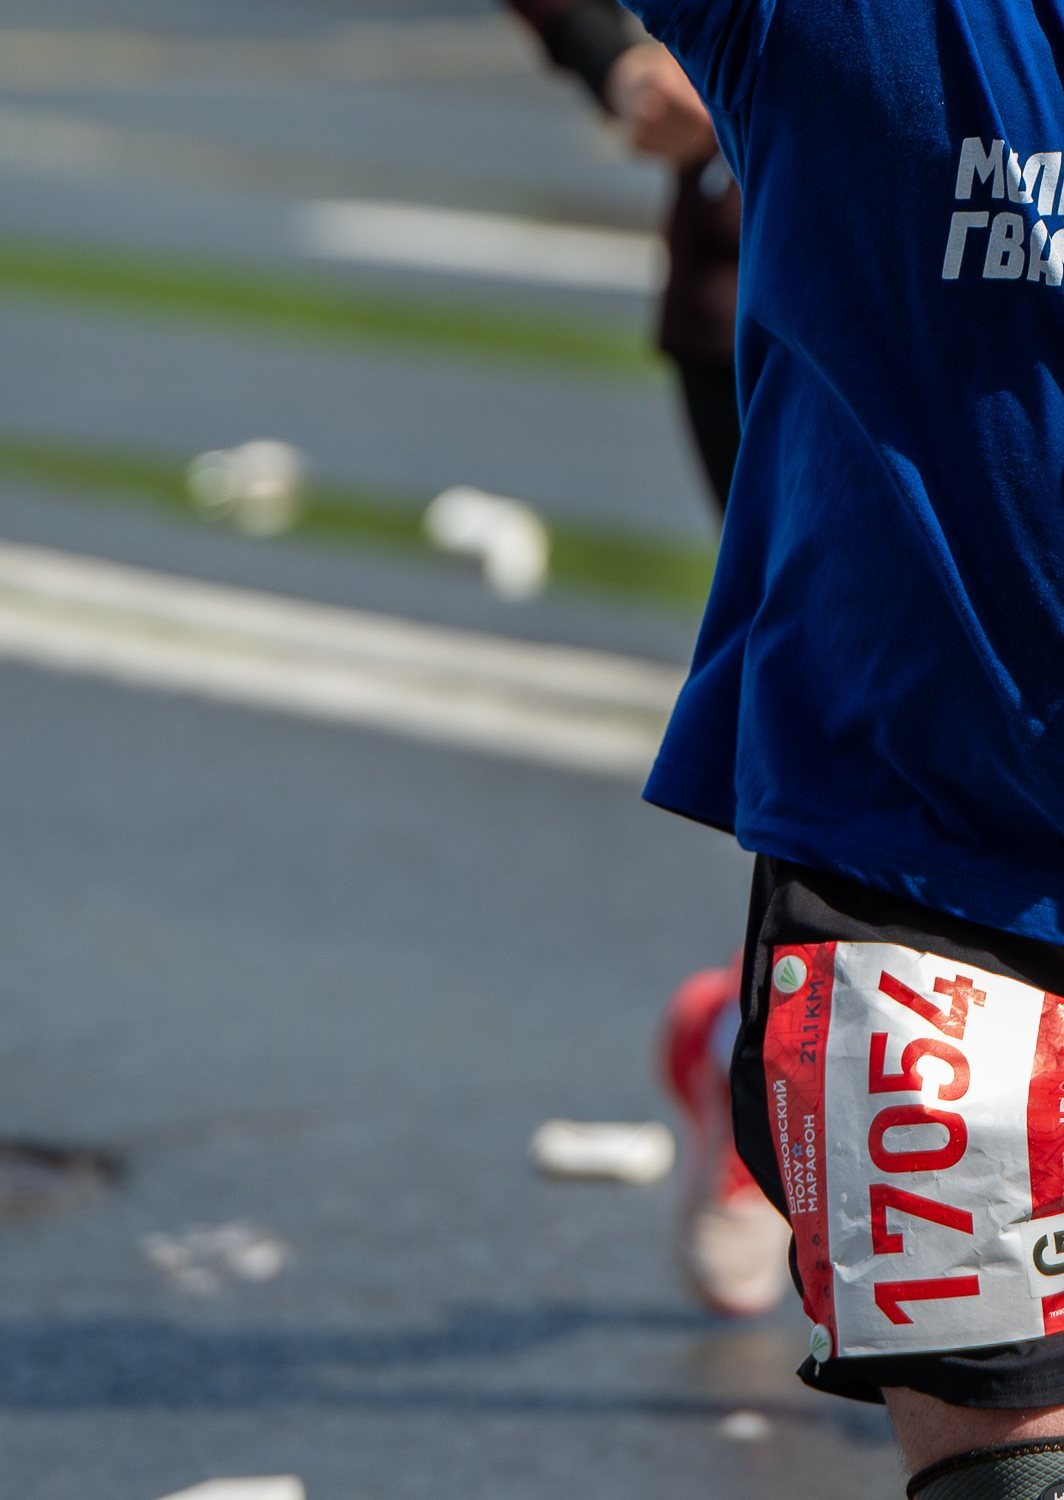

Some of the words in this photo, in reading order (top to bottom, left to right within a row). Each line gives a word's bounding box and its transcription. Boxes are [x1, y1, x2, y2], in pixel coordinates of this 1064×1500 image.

[773, 1079, 797, 1214] МОСКОВСКИЙ
[793, 1160, 806, 1214] ПОЛУ
[804, 1114, 818, 1212] МАРАФОН
[868, 970, 987, 1325] 17054
